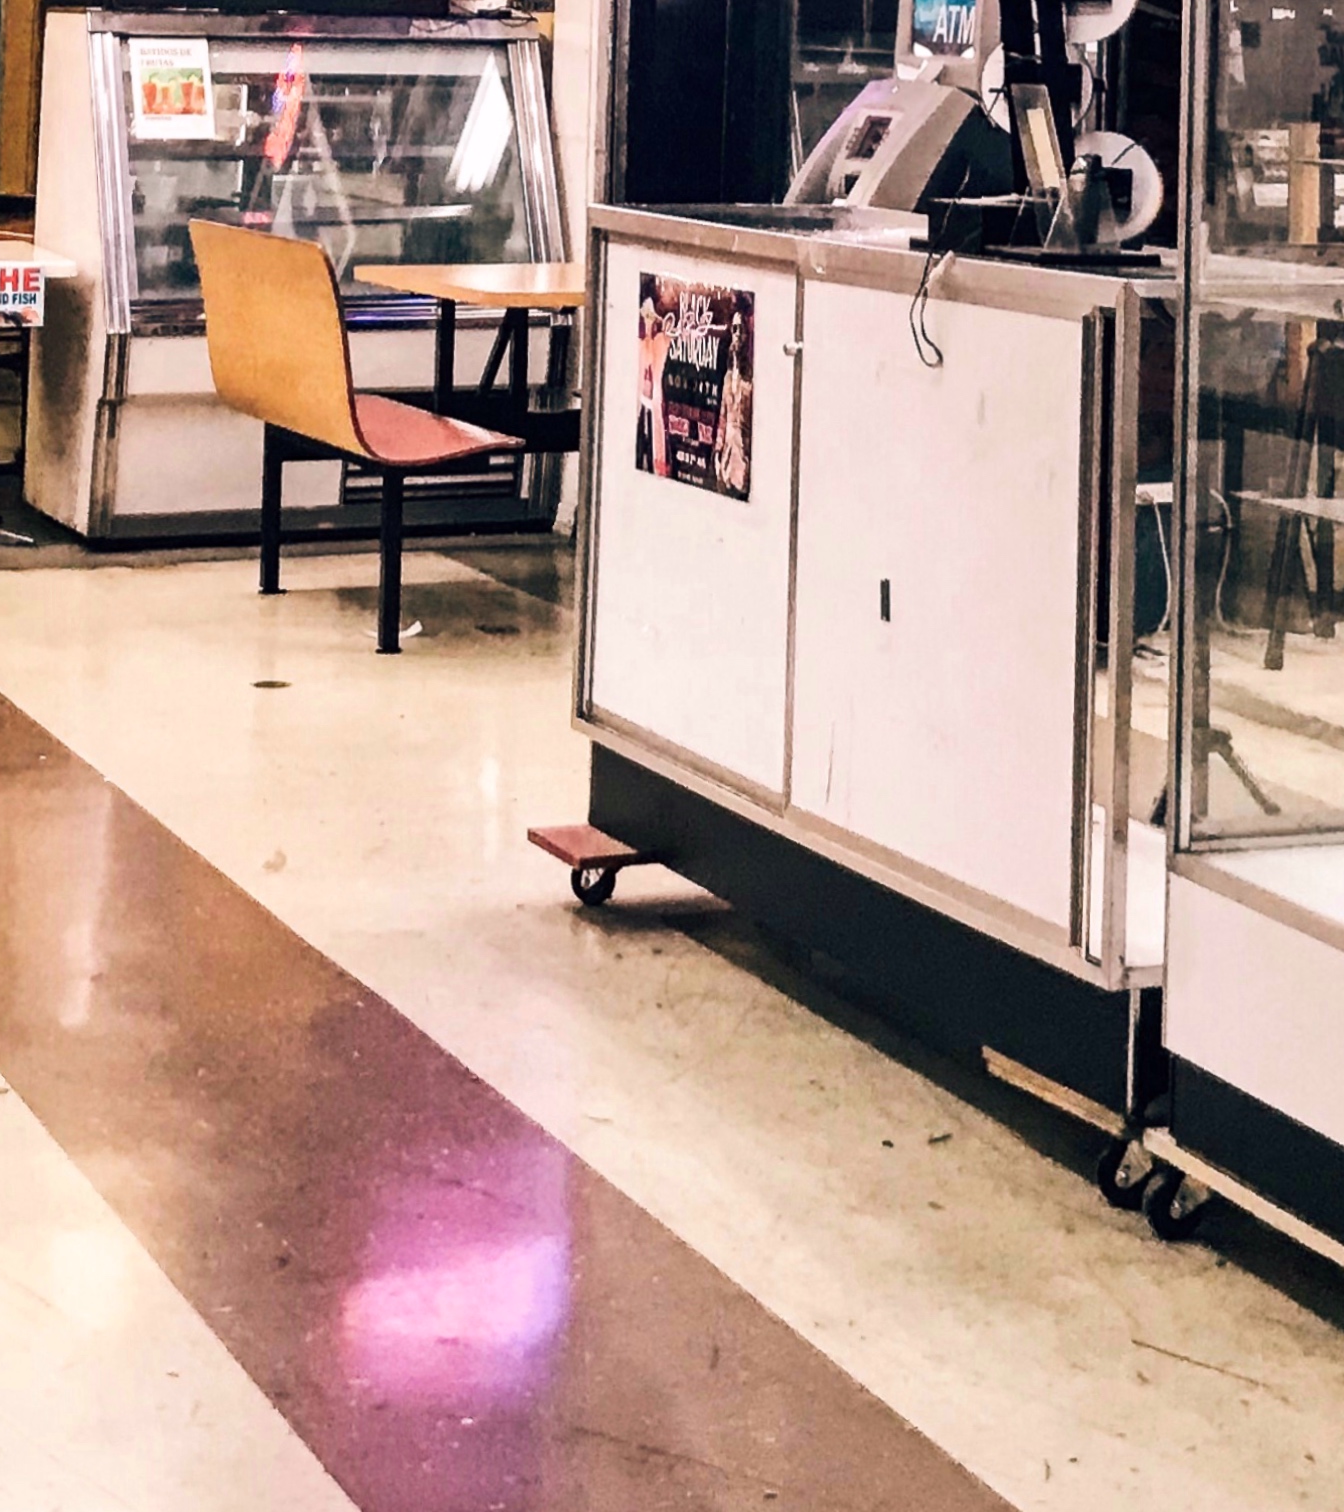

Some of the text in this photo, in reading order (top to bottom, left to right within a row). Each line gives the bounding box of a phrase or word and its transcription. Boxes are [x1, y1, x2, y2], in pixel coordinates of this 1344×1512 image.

[932, 3, 977, 45] ATM
[11, 291, 38, 306] FISH
[669, 334, 721, 372] SATURDAY
